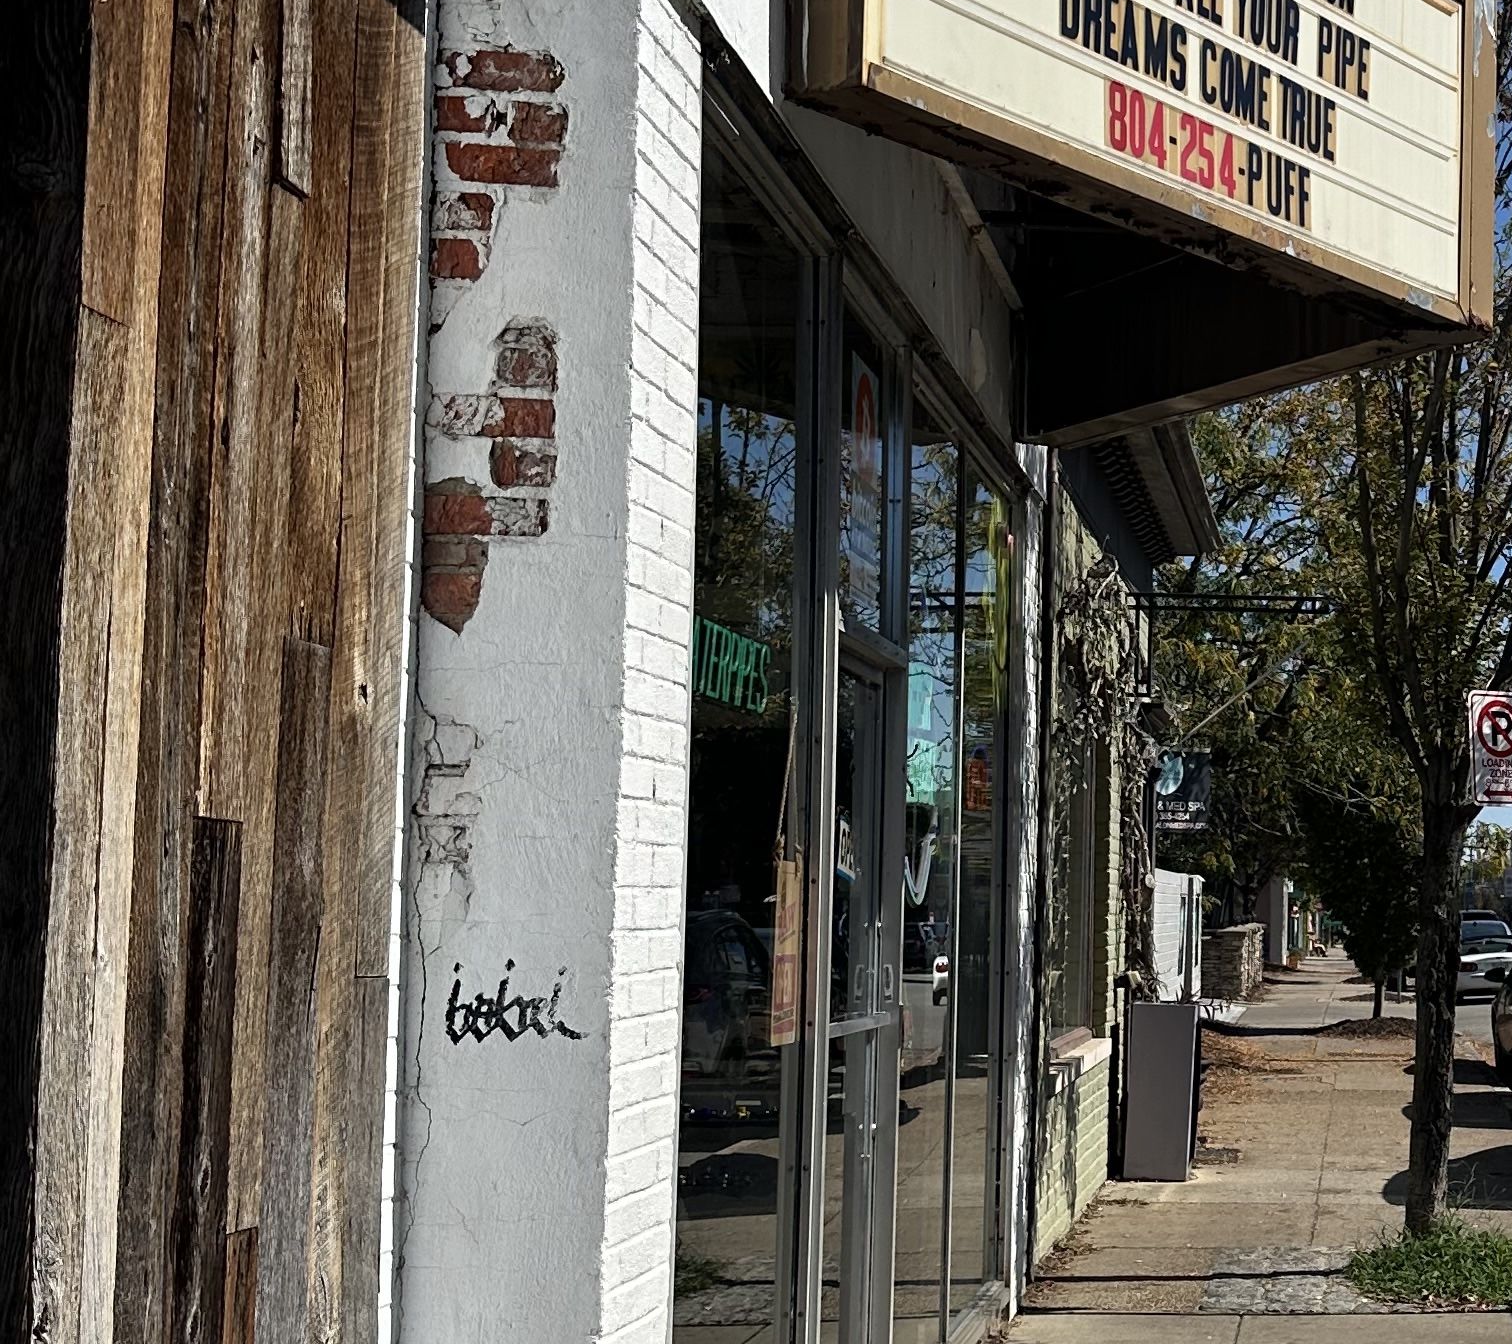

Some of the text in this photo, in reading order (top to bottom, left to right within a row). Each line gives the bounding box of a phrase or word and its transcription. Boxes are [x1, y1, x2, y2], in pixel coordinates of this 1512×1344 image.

[1200, 38, 1271, 132] COME
[1277, 74, 1336, 163] TRUE
[1317, 19, 1370, 101] PIPE
[1108, 82, 1311, 228] 804-254-PUFF
[1187, 800, 1206, 812] SPA
